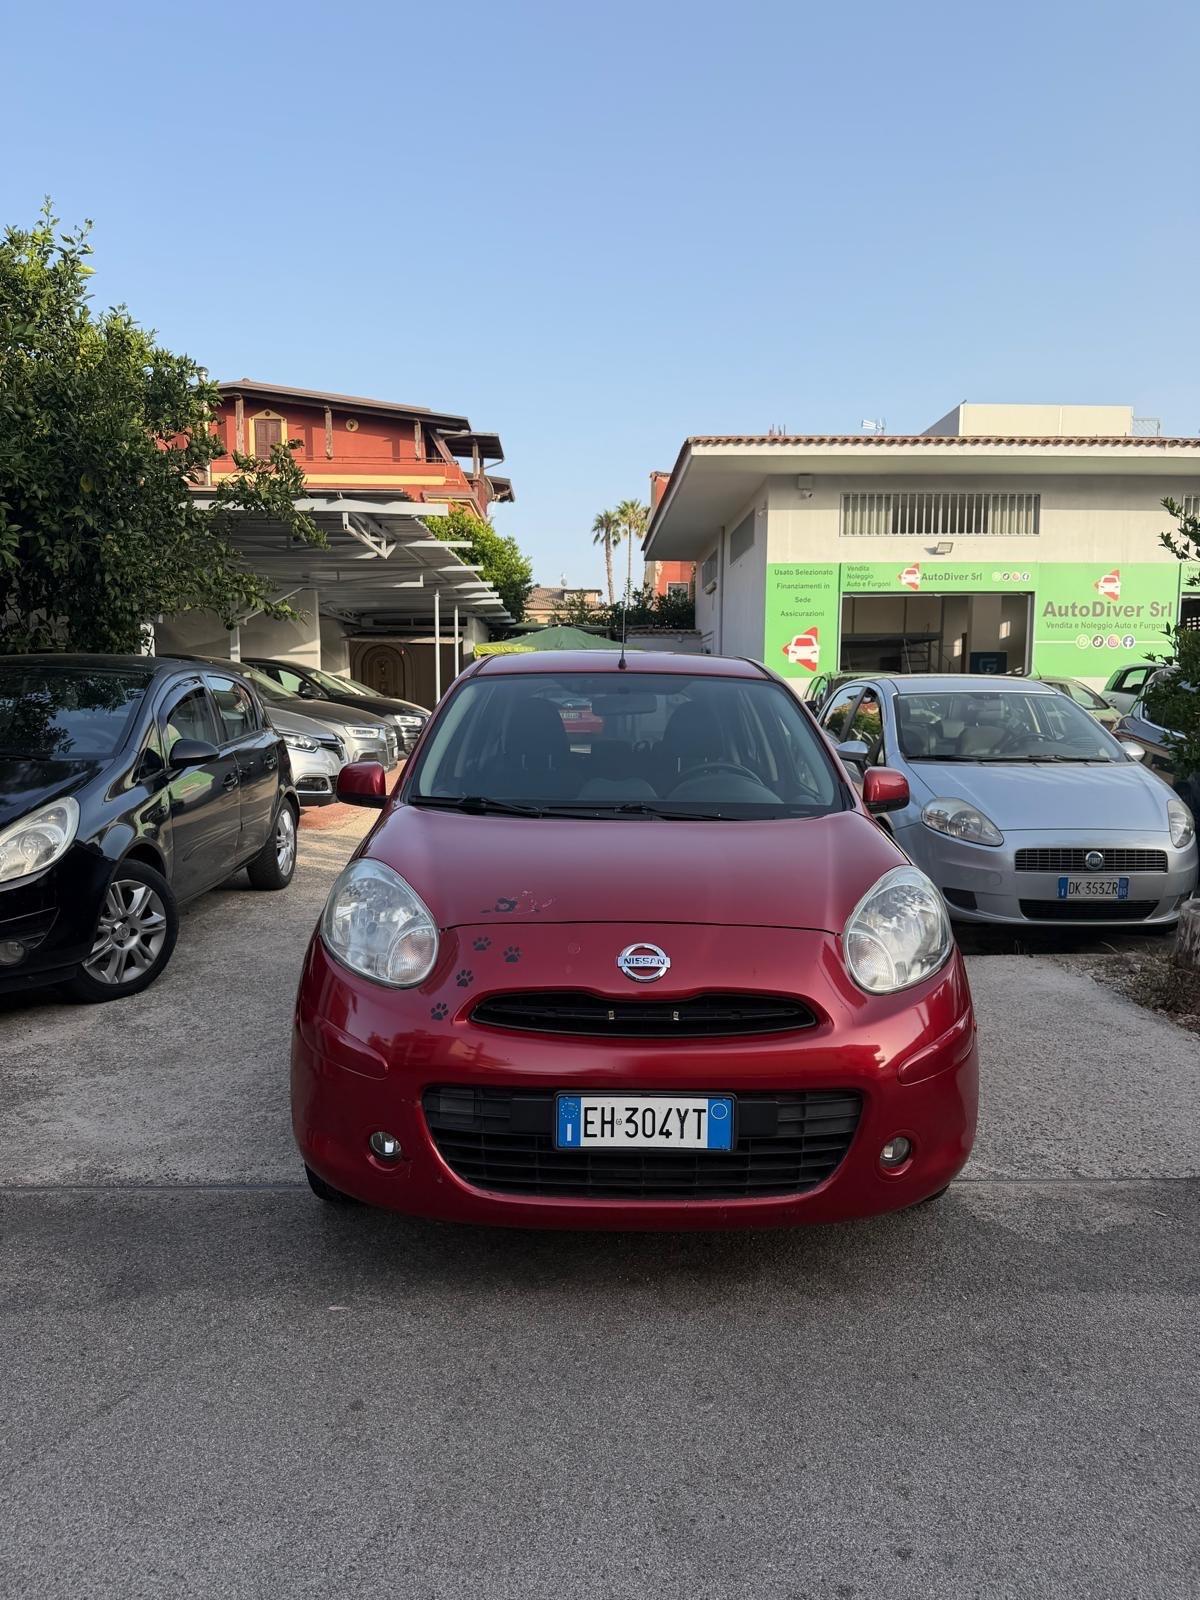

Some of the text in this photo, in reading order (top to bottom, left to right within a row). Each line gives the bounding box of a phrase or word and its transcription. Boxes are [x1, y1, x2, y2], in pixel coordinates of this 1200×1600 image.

[921, 572, 983, 581] AutoDiver Srl
[1042, 601, 1172, 618] AutoDiver Srl
[1046, 621, 1073, 629] Vendita
[1081, 621, 1113, 631] Noleggio
[1115, 621, 1132, 629] Auto
[1139, 621, 1167, 631] Furgon
[623, 957, 666, 965] NISSAN
